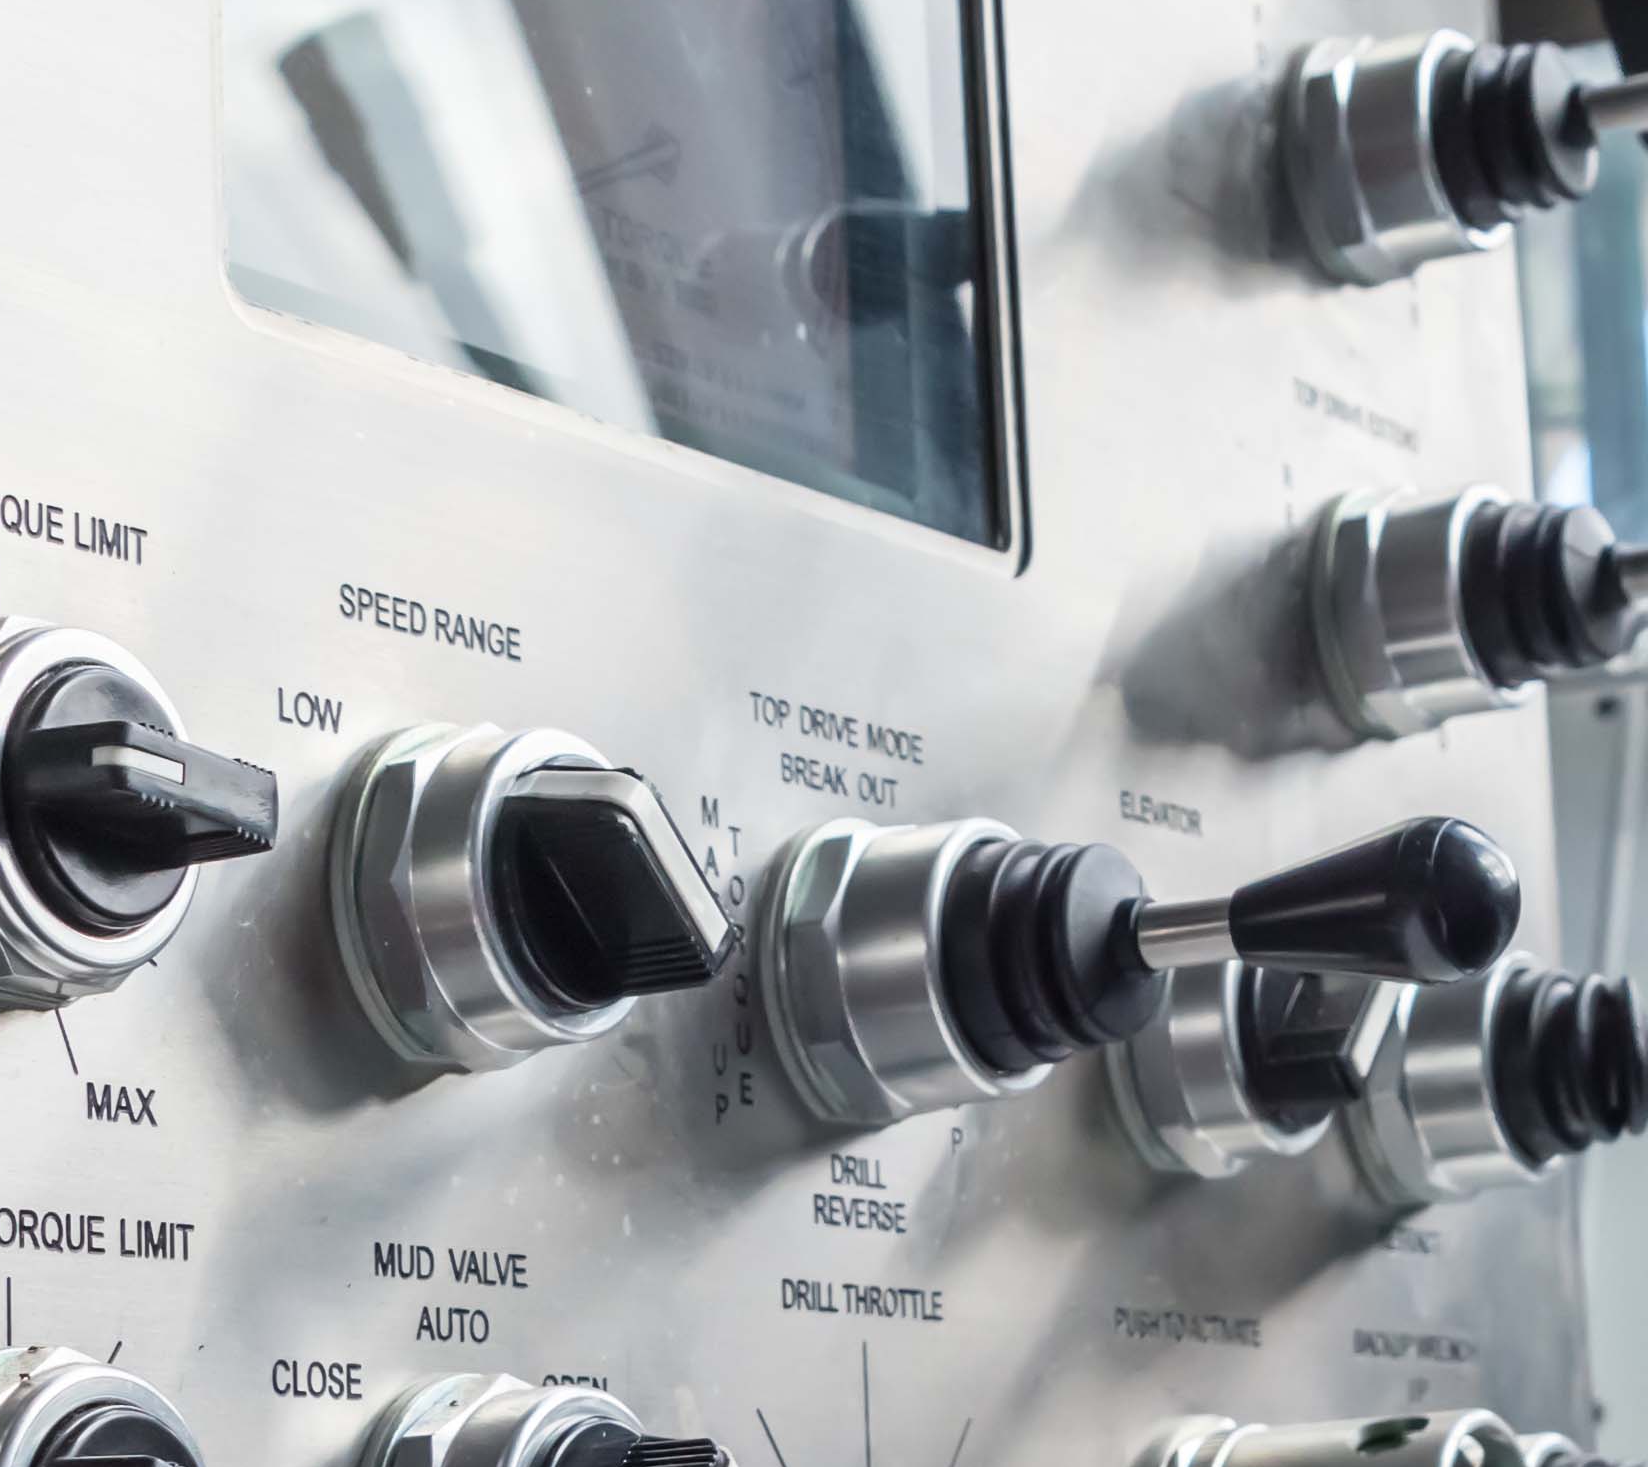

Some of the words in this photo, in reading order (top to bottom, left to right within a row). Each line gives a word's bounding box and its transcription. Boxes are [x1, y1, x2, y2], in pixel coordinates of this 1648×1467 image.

[74, 511, 149, 565] LIMIT
[339, 583, 427, 637] SPEED
[434, 607, 522, 662] RANGE
[277, 686, 343, 734] LOW
[749, 690, 791, 730] TOP
[799, 704, 859, 749] DRIVE
[866, 722, 924, 765] MODE
[780, 752, 849, 797] BREAK
[857, 771, 899, 809] OUT
[86, 1081, 159, 1127] MAX
[830, 1152, 887, 1190] DRILL
[813, 1193, 907, 1234] REVERSE
[119, 1218, 195, 1262] LIMIT
[373, 1241, 435, 1281] MUD
[447, 1247, 529, 1289] VALVE
[781, 1278, 839, 1313] DRILL
[842, 1283, 944, 1321] THROTTLE
[416, 1305, 490, 1343] AUTO
[271, 1359, 363, 1400] CLOSE
